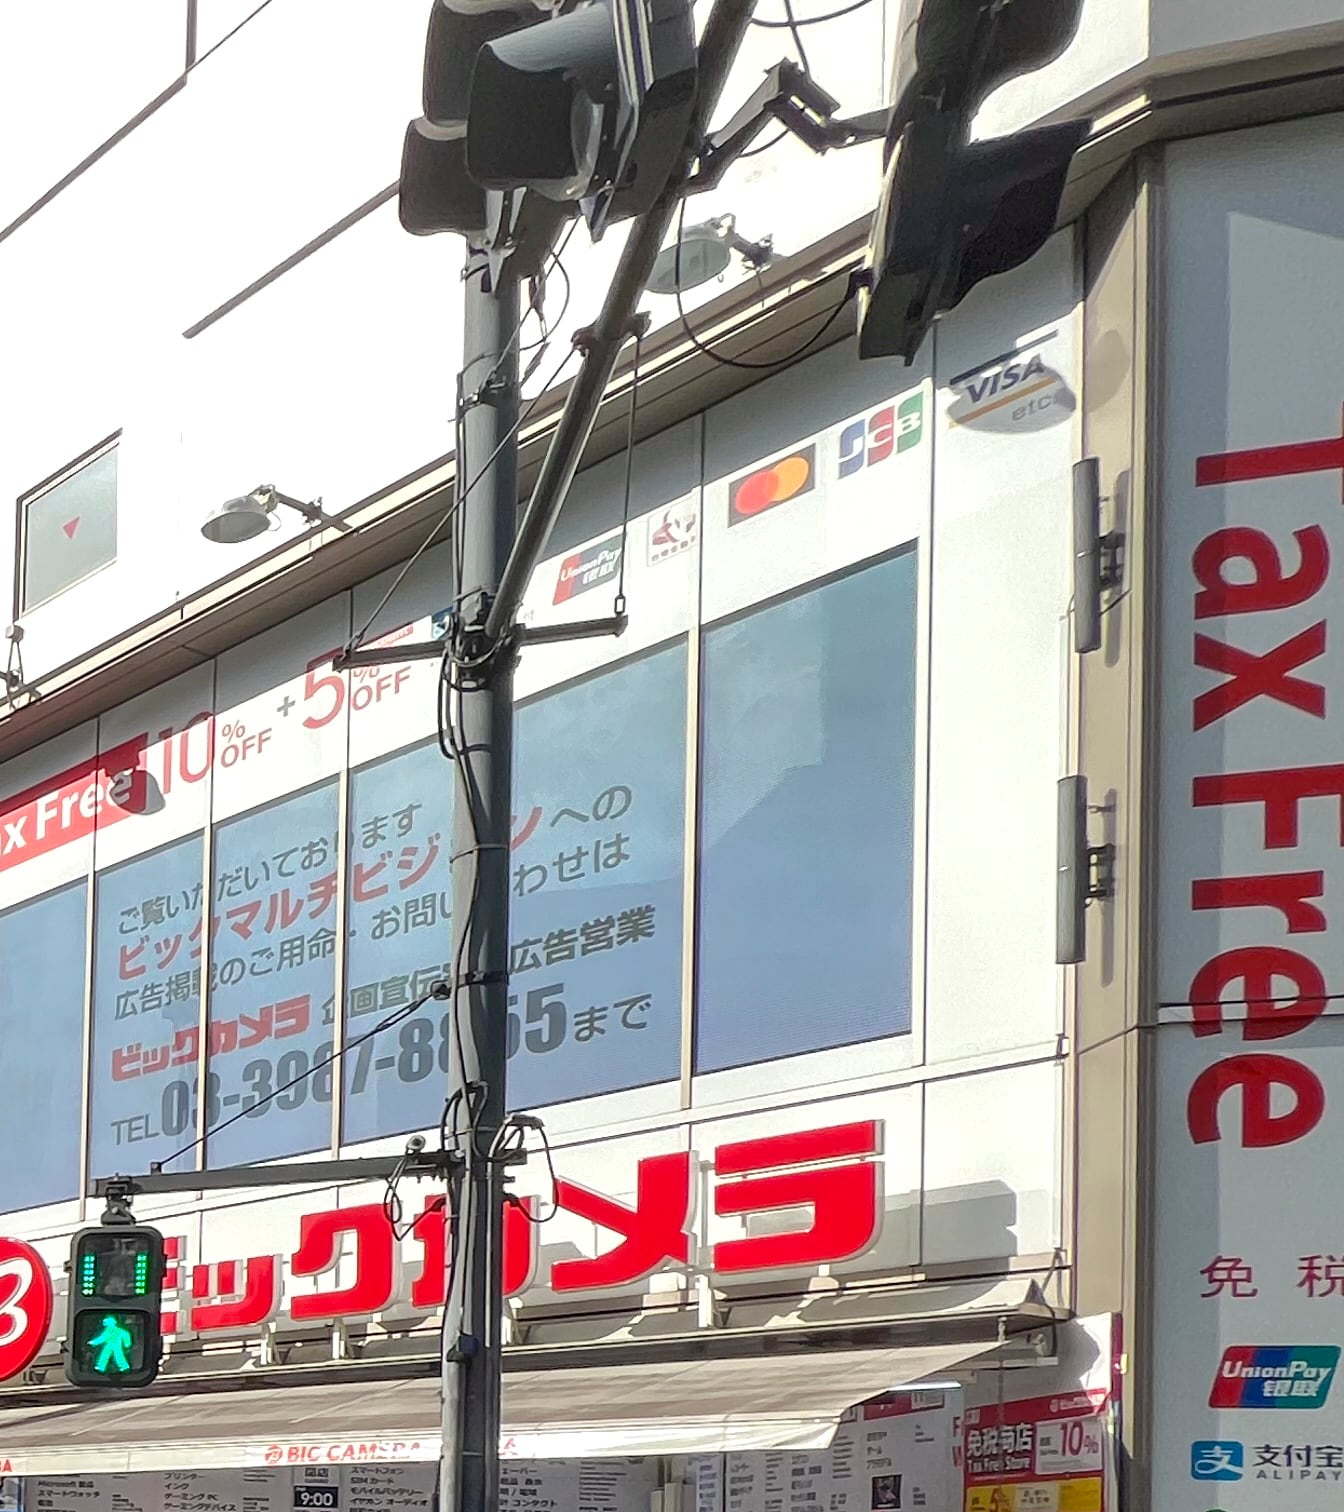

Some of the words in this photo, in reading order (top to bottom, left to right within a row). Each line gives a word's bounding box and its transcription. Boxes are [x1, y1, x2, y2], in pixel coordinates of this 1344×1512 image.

[966, 353, 1046, 403] VISA
[1186, 764, 1344, 1150] Free
[110, 1113, 161, 1148] TEL
[573, 993, 653, 1042] まで
[1221, 1359, 1334, 1386] UnionPay
[287, 1446, 321, 1463] BIC
[163, 1482, 191, 1491] インク
[1255, 1469, 1343, 1482] ALIPAY
[299, 1492, 334, 1507] 9:00
